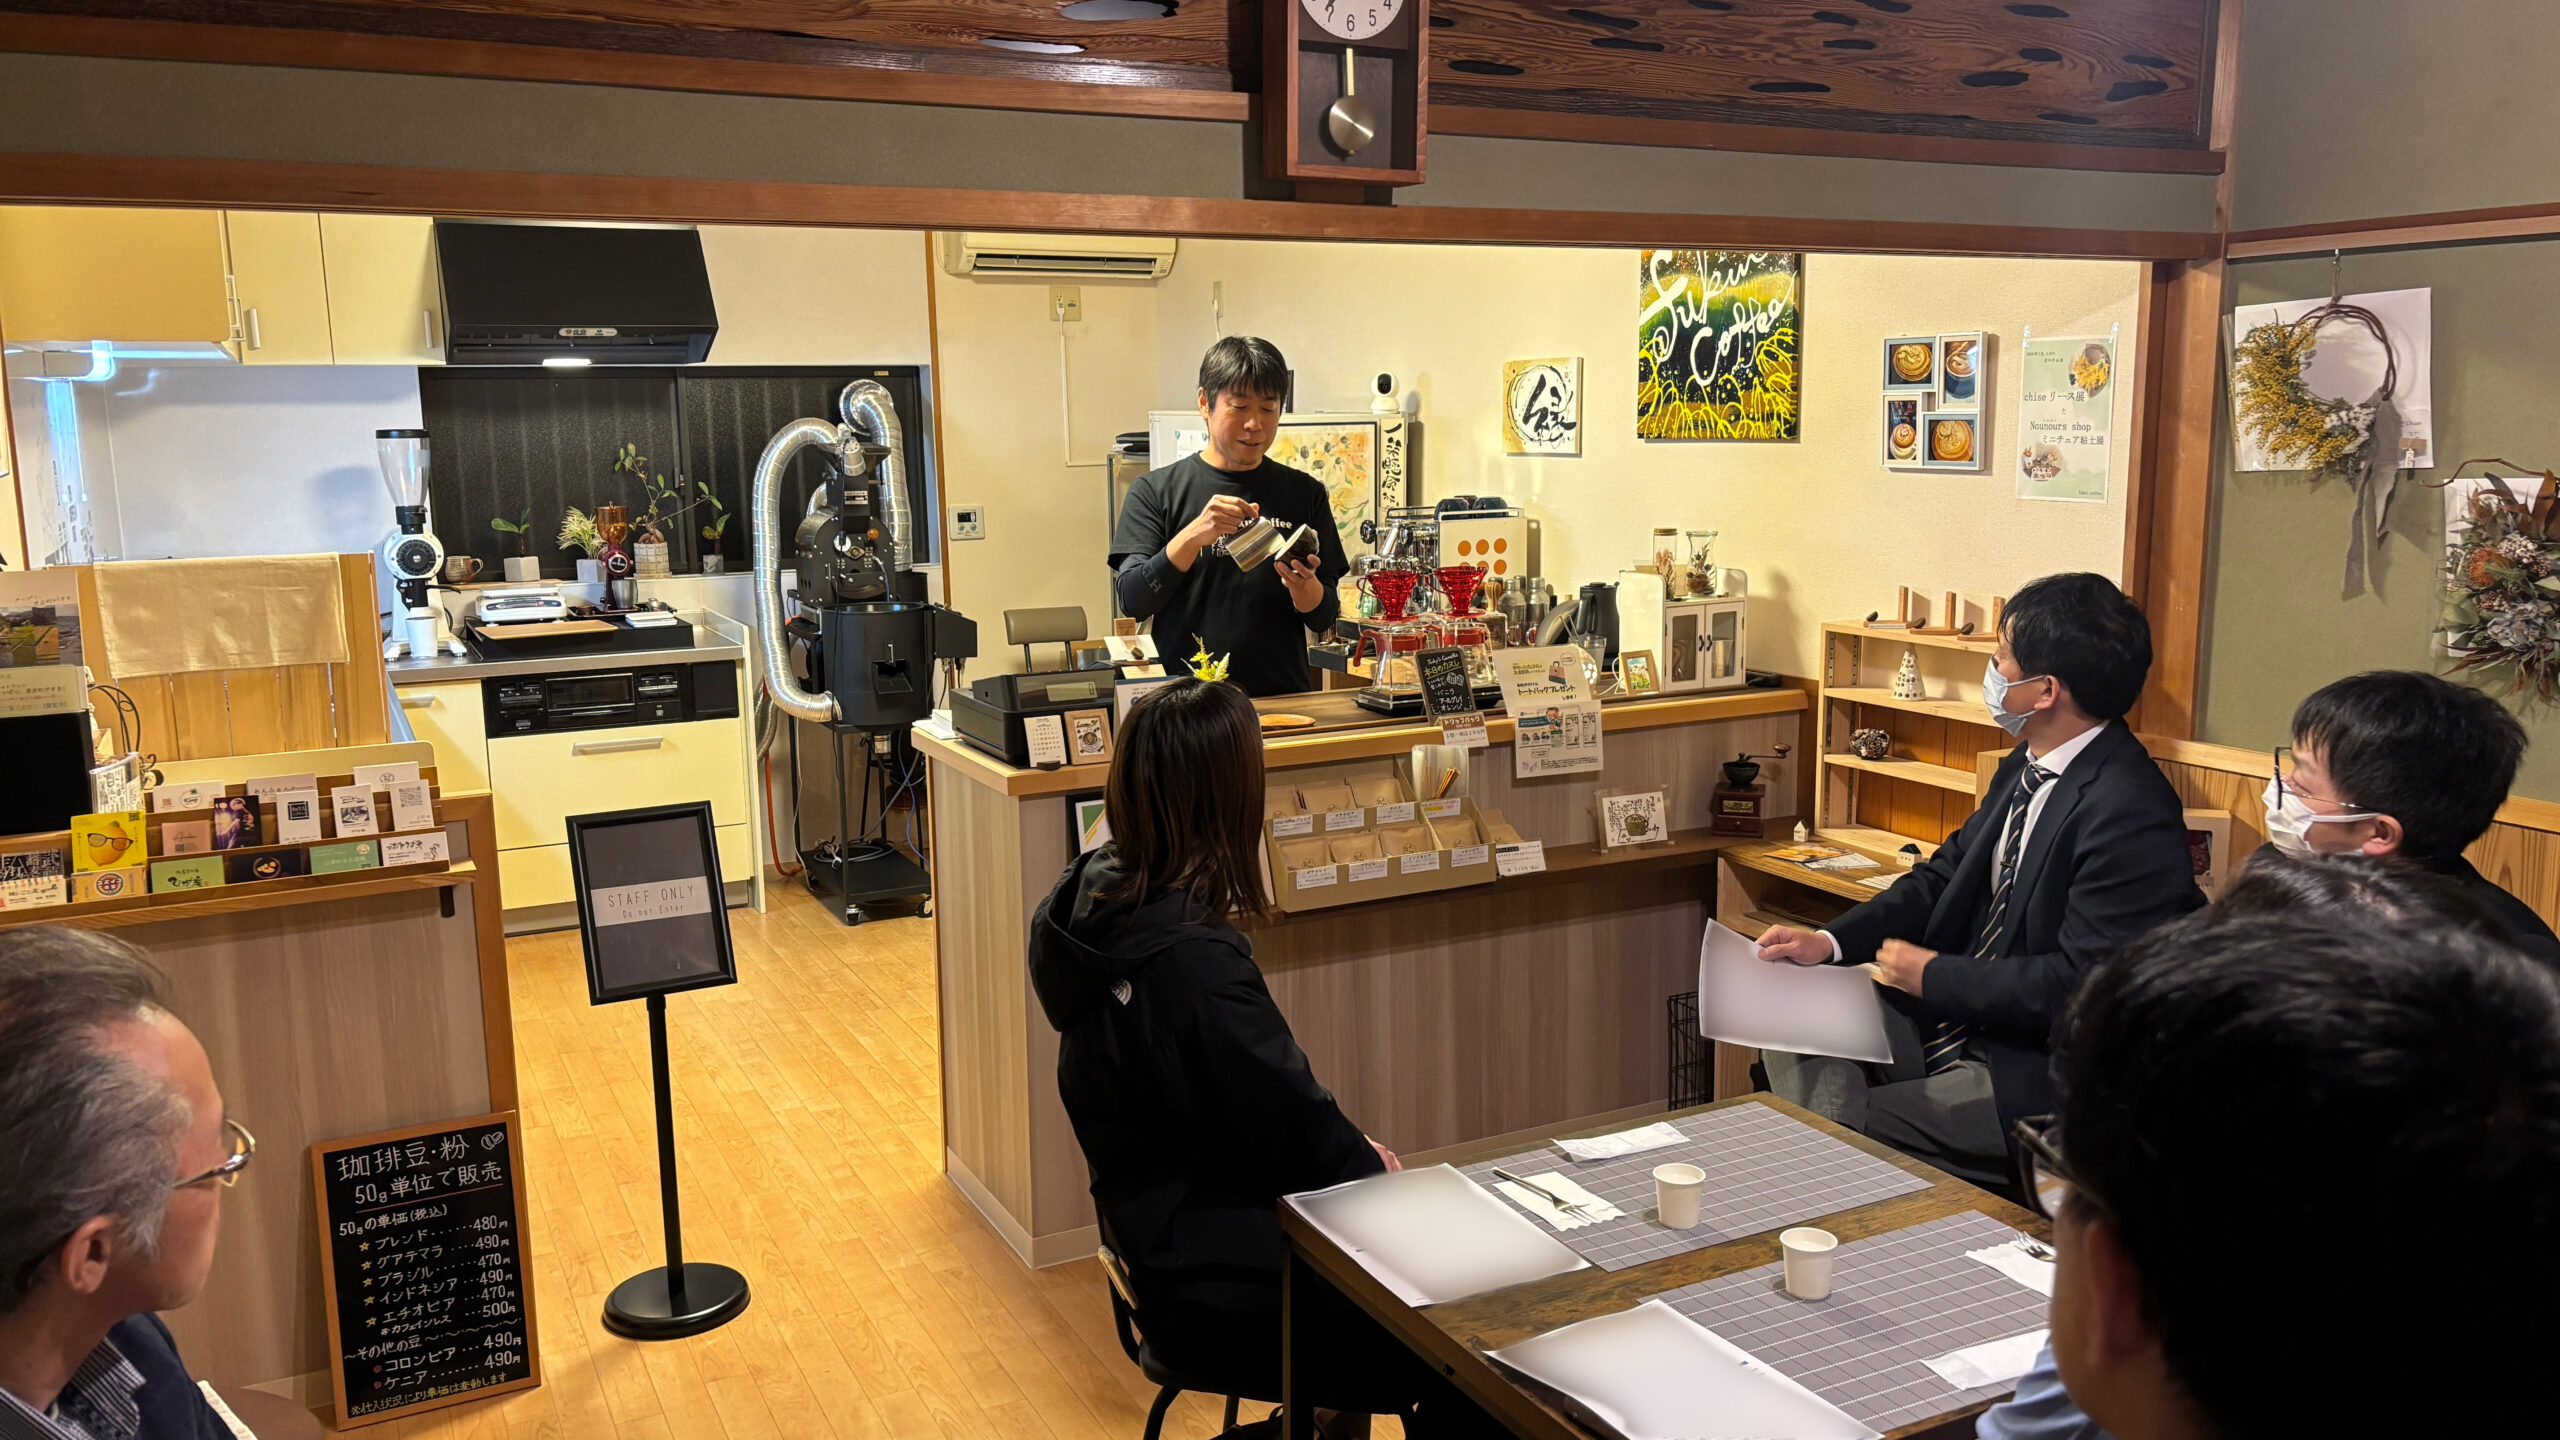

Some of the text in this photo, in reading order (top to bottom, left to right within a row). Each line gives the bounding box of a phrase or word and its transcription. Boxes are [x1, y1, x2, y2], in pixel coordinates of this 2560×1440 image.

[1325, 5, 1334, 22] 7
[1346, 14, 1355, 32] 6
[1369, 9, 1377, 27] 5
[2024, 391, 2085, 402] chise リース展
[2030, 420, 2067, 431] Nounours
[2071, 421, 2092, 433] shop
[2042, 435, 2104, 446] ミニチュア粘土展
[1424, 660, 1460, 677] 本日のカヌレ
[608, 885, 696, 908] STAFF ONLY
[622, 910, 633, 919] Do
[355, 1160, 503, 1205] 50g単位で販売
[376, 1215, 508, 1250] ブレンド 480円
[376, 1234, 510, 1267] グアテマラ 490円
[378, 1253, 511, 1288] ブラジル 470円
[379, 1269, 513, 1305] インドネシア 490円
[382, 1284, 515, 1324] エチオピア 470円
[482, 1301, 516, 1318] 500円
[385, 1332, 522, 1372] コロンビア 490円
[384, 1350, 521, 1391] ケニア 490円
